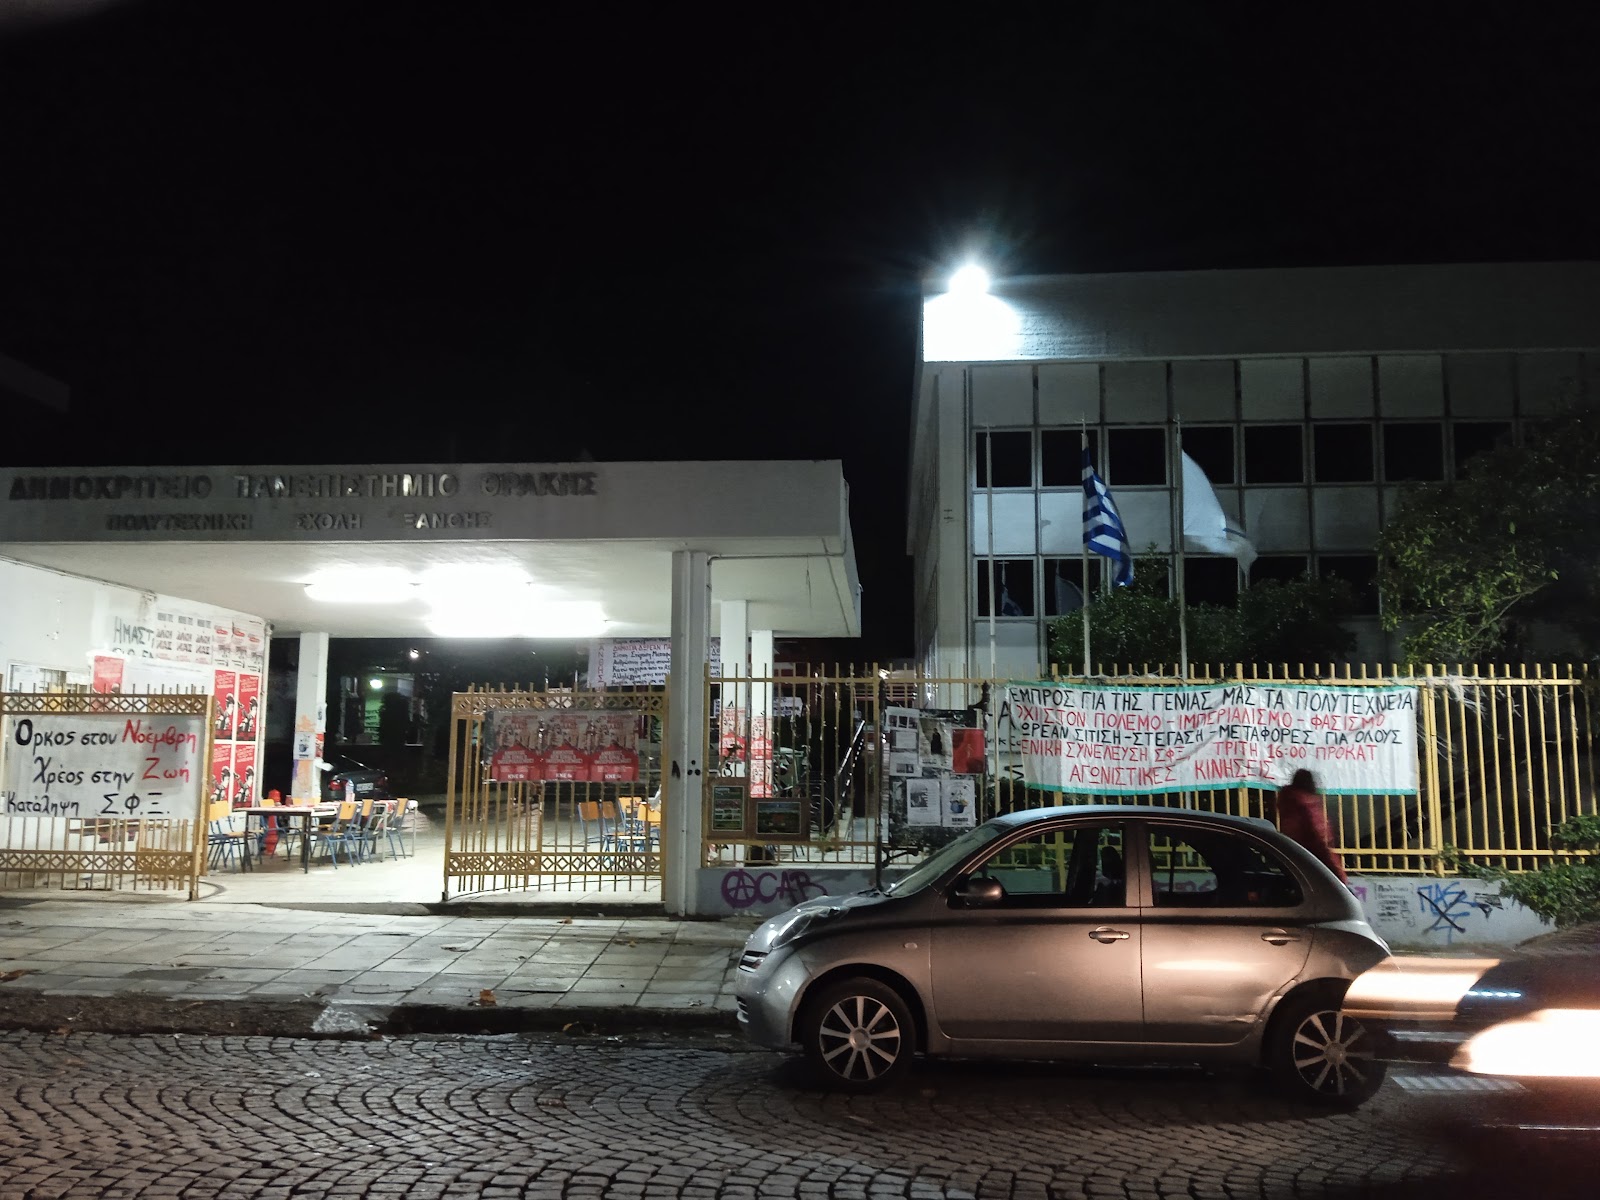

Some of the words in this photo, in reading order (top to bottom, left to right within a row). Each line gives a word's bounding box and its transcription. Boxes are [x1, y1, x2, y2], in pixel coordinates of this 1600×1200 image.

[233, 472, 460, 500] ΠΑΝΕΠΙΣΤΗΜΙΟ
[480, 470, 599, 498] ΘΡΑΚΗΣ
[296, 512, 363, 531] ΣΧΟΛΗ
[403, 511, 494, 531] ΞΑΝΘΗΣ
[1009, 687, 1075, 708] ΕΜΠΡΟΣ
[1081, 691, 1106, 711] ΓΙΑ
[1111, 692, 1143, 712] ΤΗΣ
[1152, 691, 1213, 711] ΓΕΝΙΑΣ
[1222, 685, 1256, 706] ΜΑΣ
[1265, 688, 1285, 710] ΤΑ
[1296, 690, 1414, 716] ΠΟΛΥΤΕΧΝΕΙΑ
[1021, 722, 1069, 739] ΩΡΕΑΝ
[1325, 731, 1349, 745] ΓΙΑ
[1354, 729, 1403, 745] ΟΛΟΥΣ
[1043, 708, 1086, 728] ΣΤΟΝ
[1094, 712, 1162, 732] ΠΟΛΕΜΟ
[1178, 707, 1293, 731] ΙΜΠΕΡΙΑΛΙΣΜΟ
[1310, 713, 1386, 732] ΦΑΣΙΣΜΟ
[80, 731, 118, 746] στον
[121, 718, 197, 754] Νοέμβρη
[1021, 739, 1062, 757] ΕΝΙΚΗ
[1066, 741, 1148, 762] ΣΥΝΕΛΕΥΣΗ
[1215, 740, 1258, 757] ΤΡΙΤΗ
[1266, 744, 1307, 759] 16:00
[1315, 744, 1378, 762] ΠΡΟΚΑΤ
[91, 770, 135, 790] στην
[142, 757, 190, 784] Ζωή
[1069, 764, 1178, 786] ΑΓΩΝΙΣΤΙΚΕΣ
[1194, 758, 1276, 781] ΚΙΝΗΣΕΙΣ
[7, 790, 80, 818] Κατάληψη
